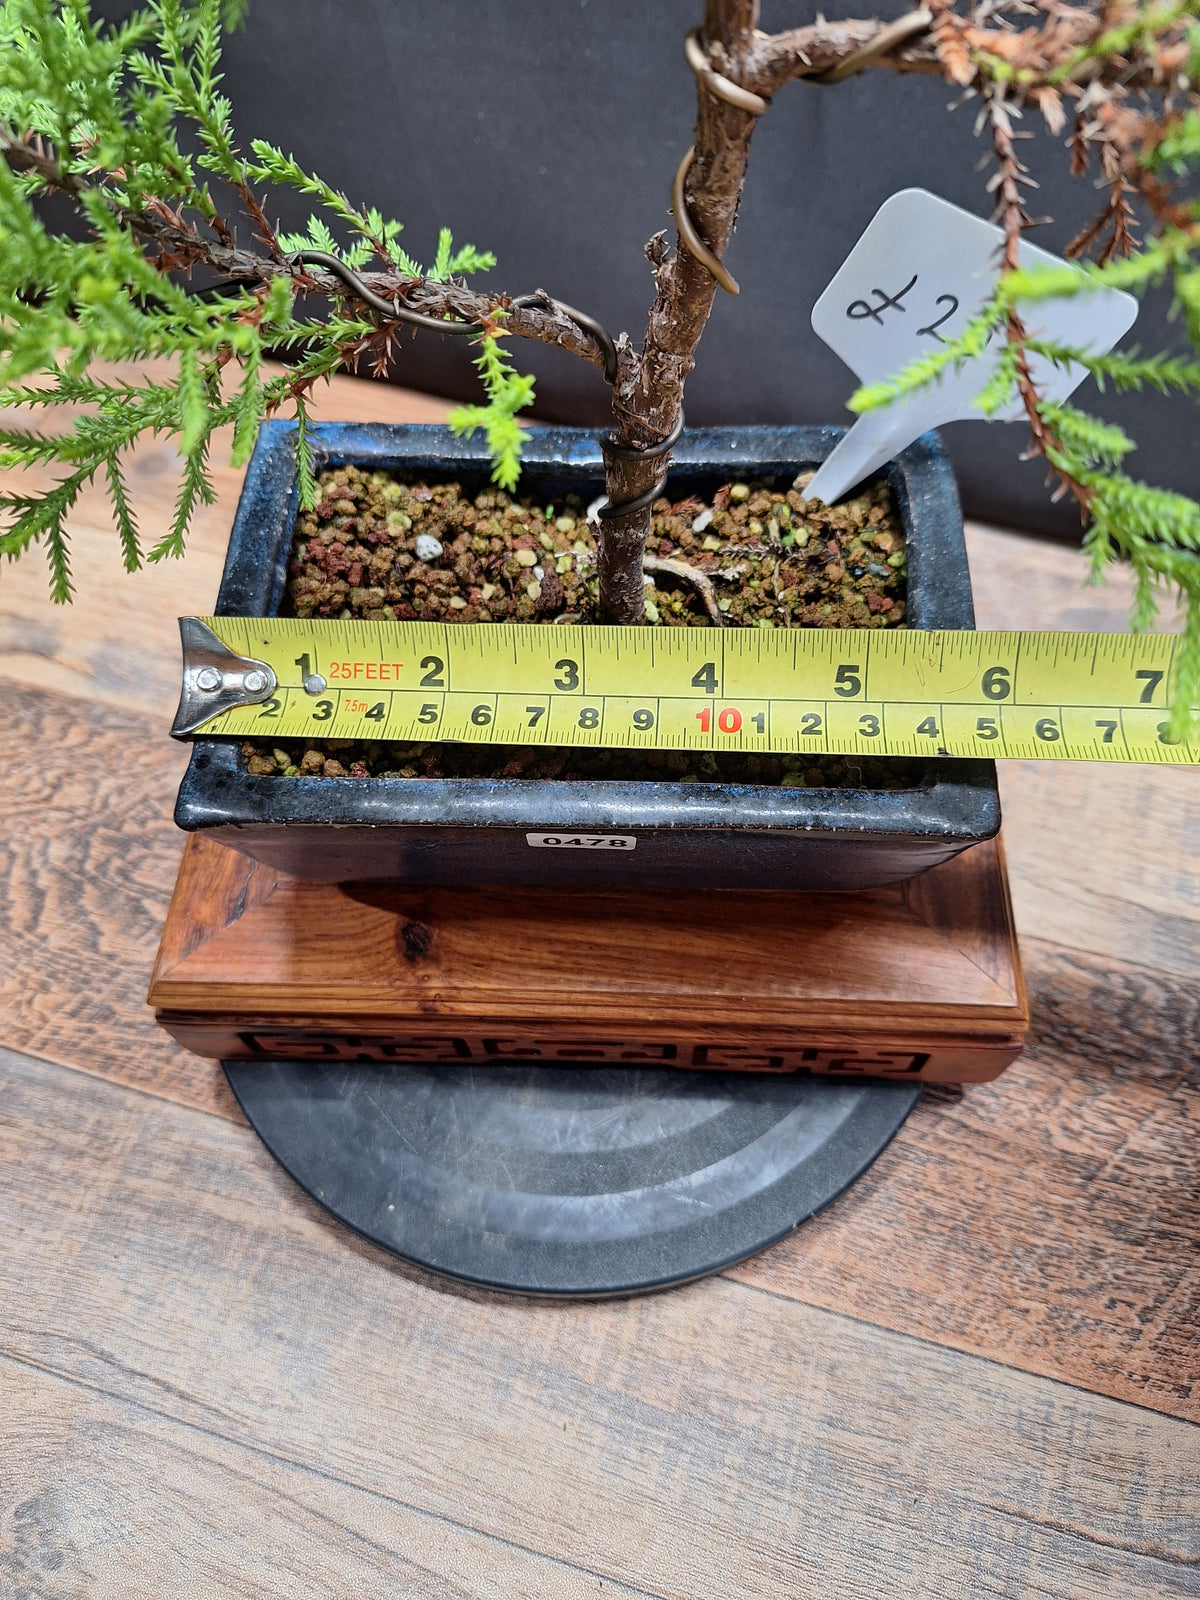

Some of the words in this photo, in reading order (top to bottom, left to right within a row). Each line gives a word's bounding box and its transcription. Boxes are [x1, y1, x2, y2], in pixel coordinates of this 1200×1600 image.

[294, 653, 312, 681] 1
[329, 662, 404, 681] 25FEET
[419, 655, 445, 687] 2
[554, 659, 580, 691] 3
[691, 662, 719, 694] 4
[834, 665, 861, 697] 5
[981, 667, 1011, 700] 6
[1135, 670, 1164, 703] 7
[259, 699, 281, 719] 2
[312, 700, 333, 720] 3
[344, 699, 368, 713] 7.5m
[364, 702, 386, 722] 4
[417, 703, 438, 724] 5
[471, 705, 492, 726] 6
[525, 706, 545, 727] 7
[578, 708, 599, 729] 8
[632, 709, 654, 730] 9
[696, 708, 742, 733] 10
[751, 712, 765, 733] 1
[801, 713, 823, 735] 2
[858, 714, 881, 737] 3
[916, 717, 939, 738] 4
[976, 717, 999, 740] 5
[1035, 718, 1059, 741] 6
[1095, 720, 1118, 743] 7
[542, 837, 628, 848] 0478
